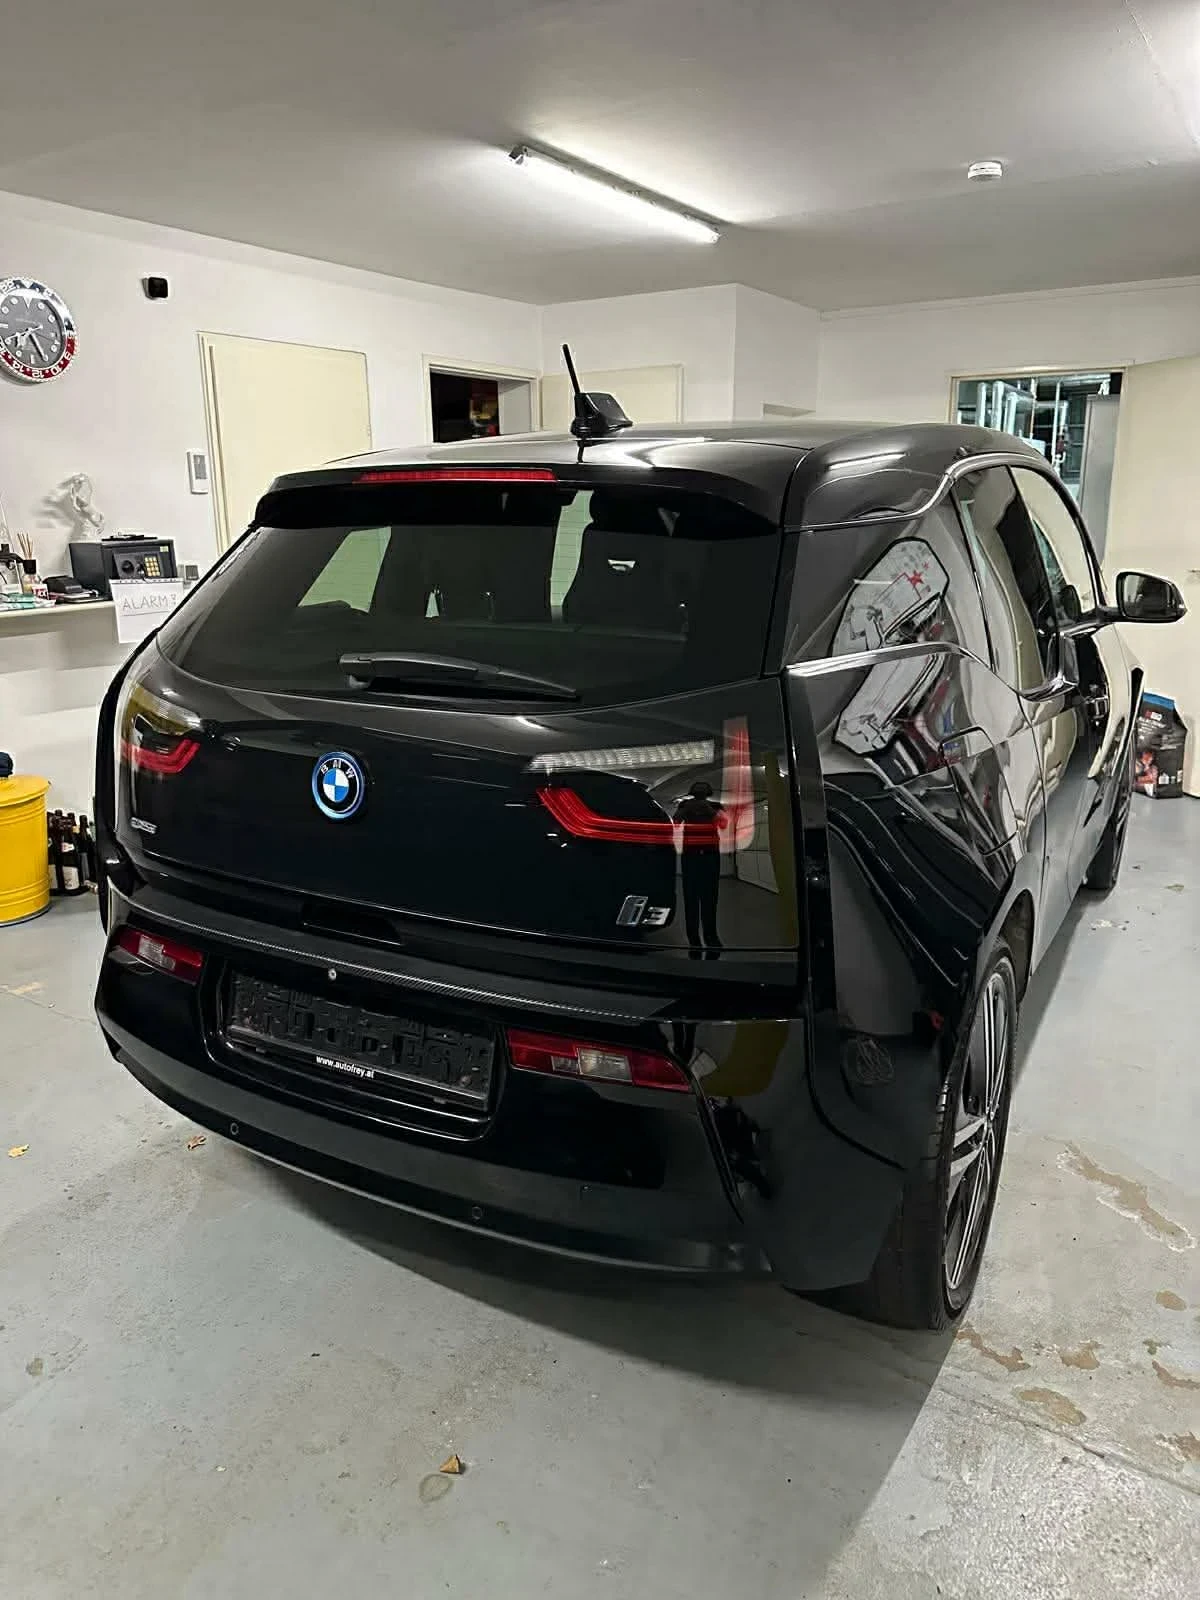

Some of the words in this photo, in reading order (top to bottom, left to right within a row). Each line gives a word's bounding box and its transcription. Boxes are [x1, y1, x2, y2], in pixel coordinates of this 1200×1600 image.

[31, 369, 44, 378] 12
[122, 595, 169, 611] ALARM
[320, 759, 355, 778] BMW
[616, 895, 671, 926] i3
